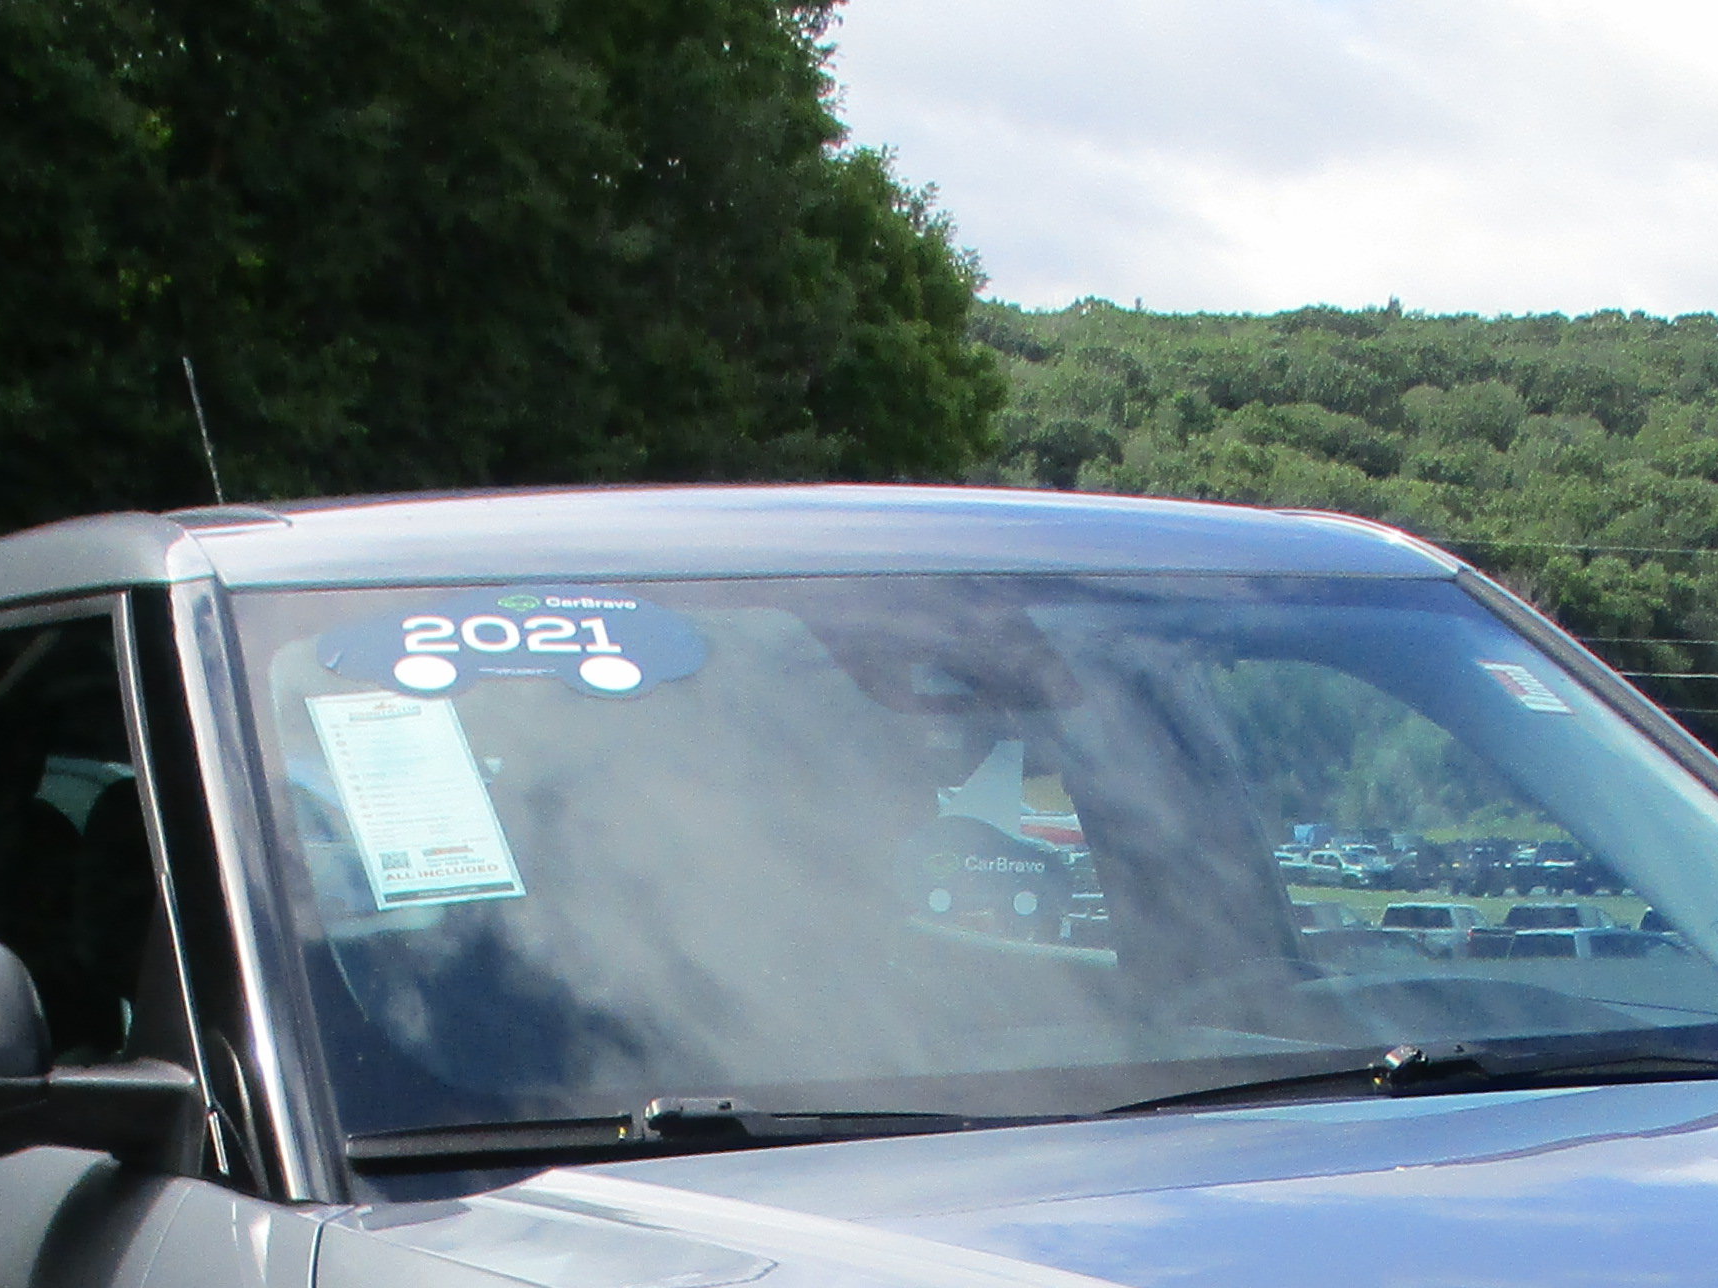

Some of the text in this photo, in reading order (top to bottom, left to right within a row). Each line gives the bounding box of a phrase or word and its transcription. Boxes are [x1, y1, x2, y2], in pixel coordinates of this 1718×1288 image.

[544, 595, 637, 611] CarBravo
[401, 614, 623, 653] 2021
[386, 863, 499, 881] ALL INCLUDED
[965, 855, 1046, 873] CarBravo
